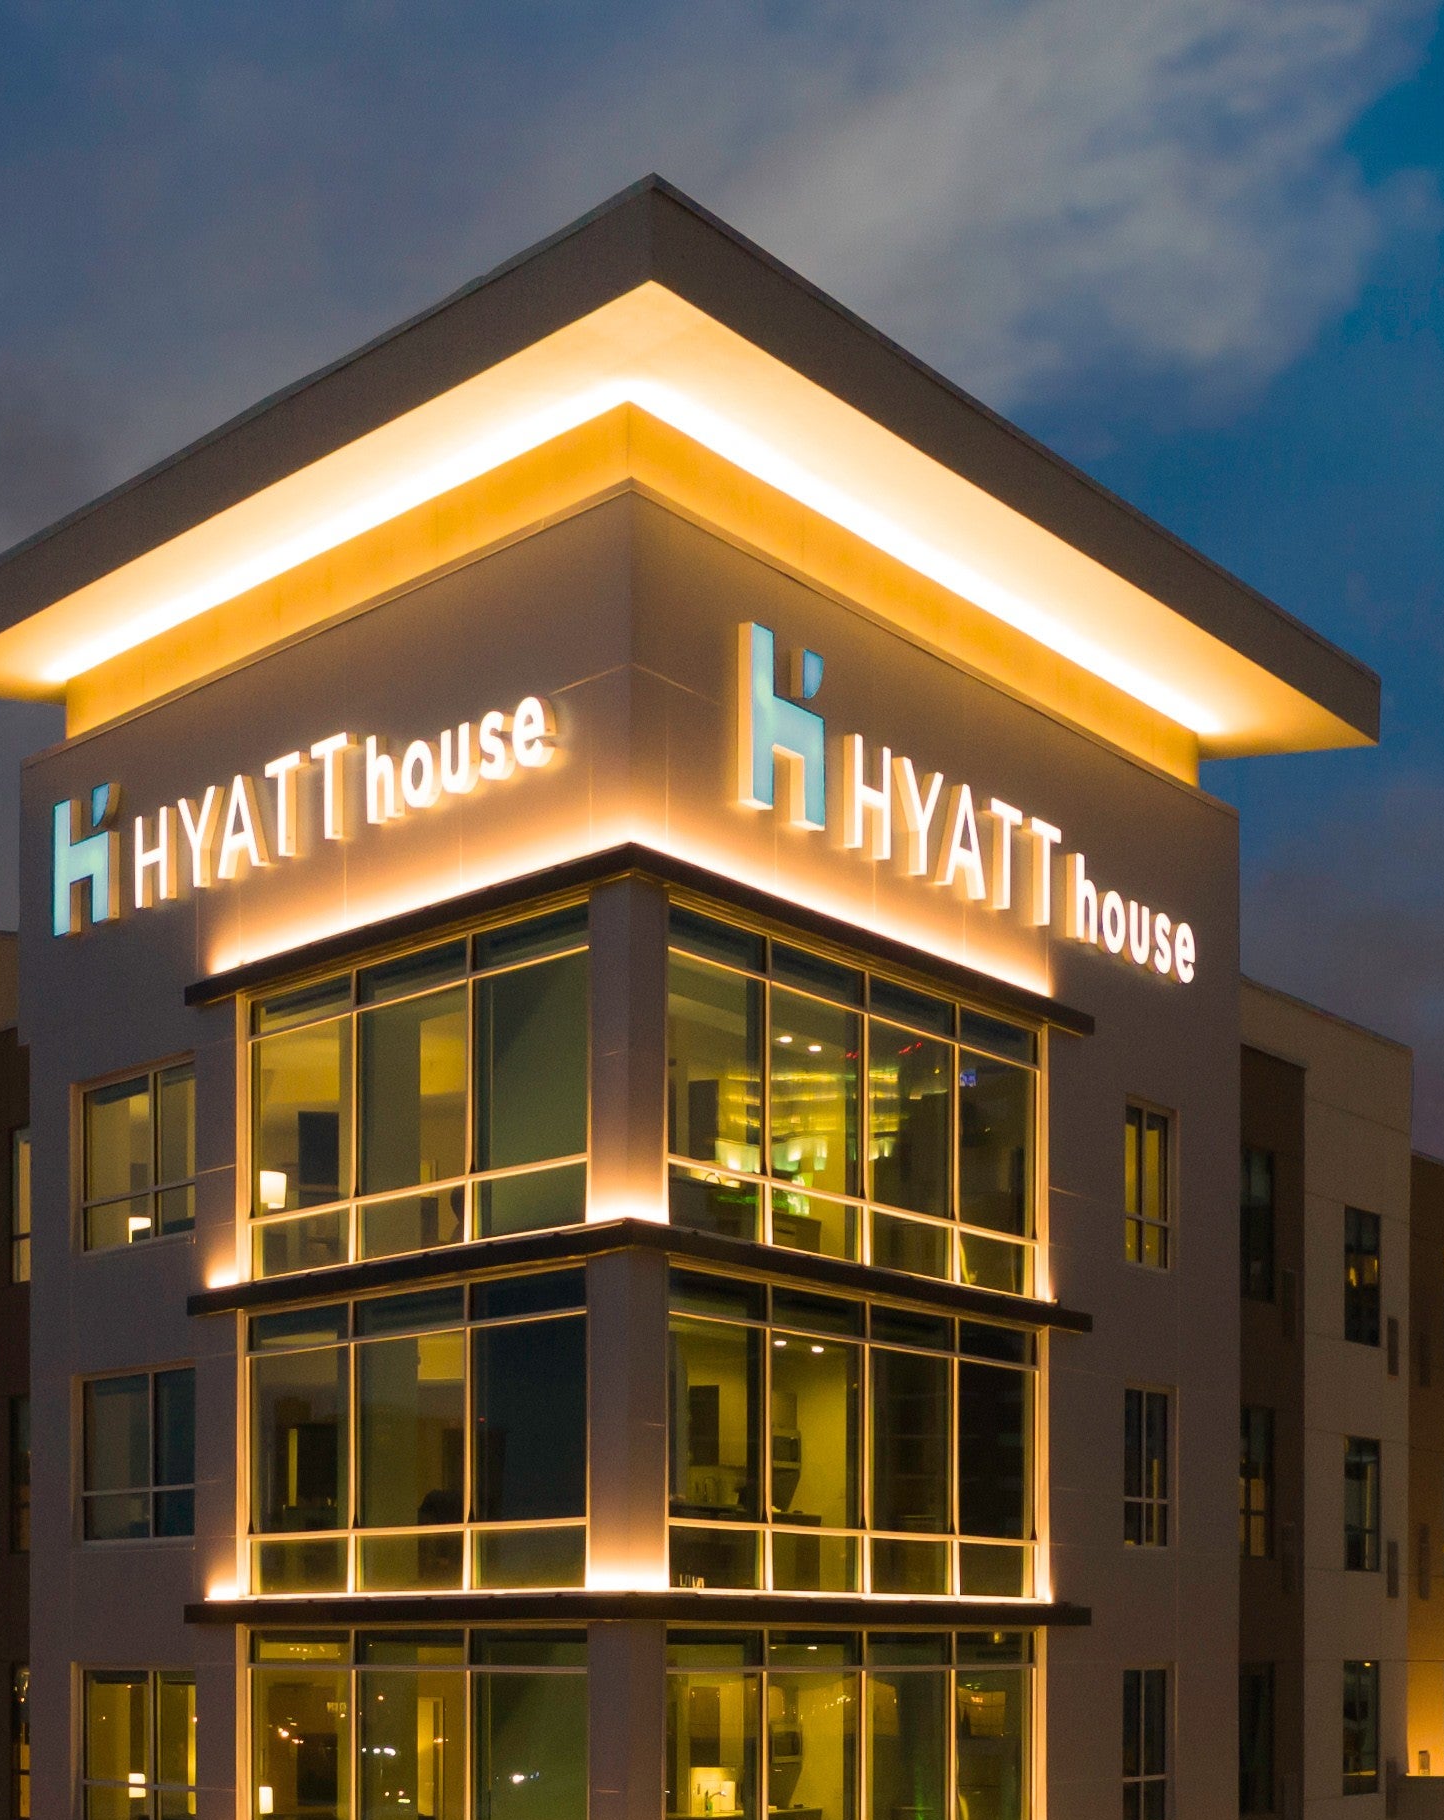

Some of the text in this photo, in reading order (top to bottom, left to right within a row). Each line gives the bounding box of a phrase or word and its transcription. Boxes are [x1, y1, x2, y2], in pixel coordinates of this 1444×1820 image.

[133, 732, 352, 908] HYATT
[366, 696, 553, 825] house
[843, 733, 1062, 927] HYATT
[1067, 852, 1197, 985] house
